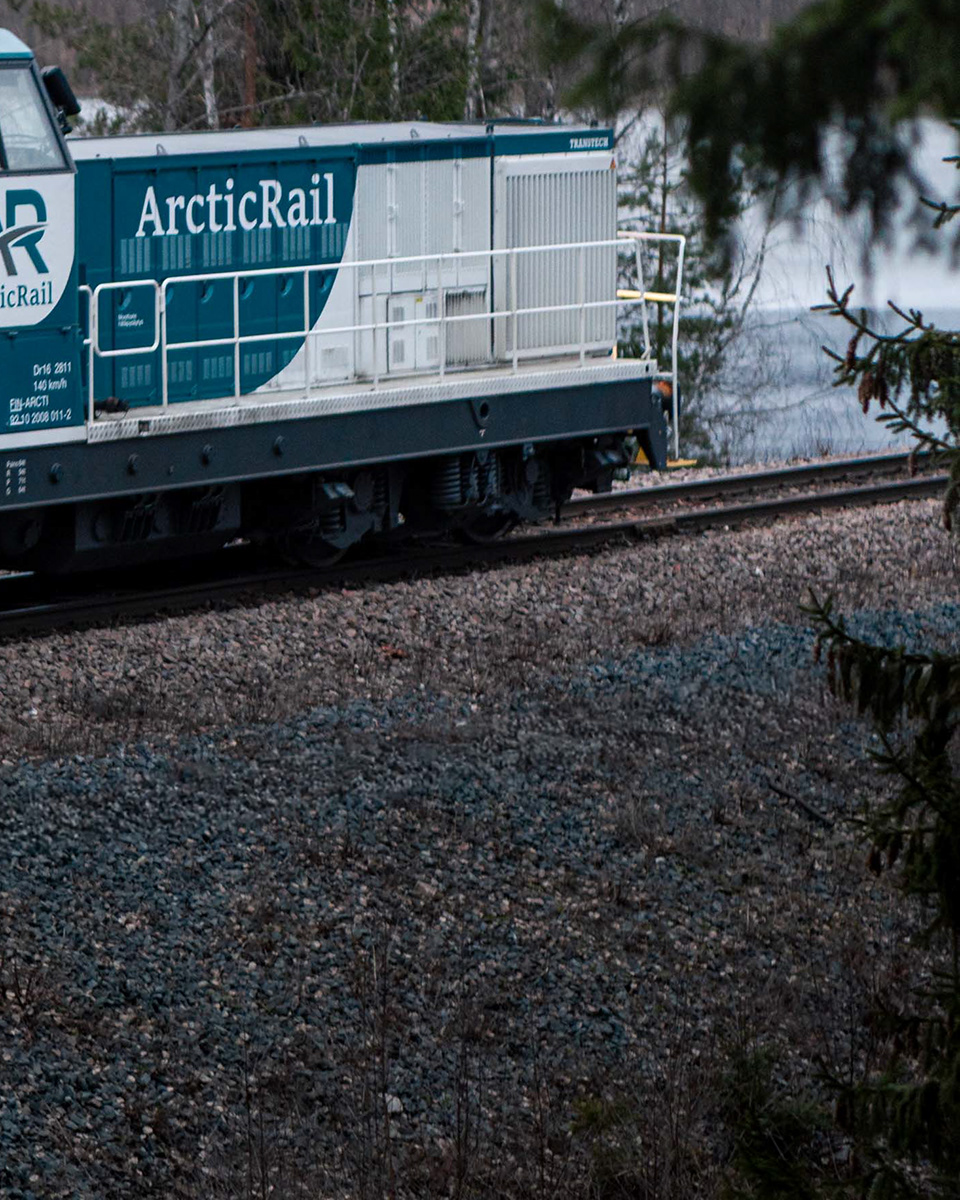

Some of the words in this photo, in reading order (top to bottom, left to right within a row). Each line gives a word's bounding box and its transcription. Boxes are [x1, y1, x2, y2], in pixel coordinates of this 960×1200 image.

[135, 172, 337, 237] ArcticRail
[33, 362, 52, 377] Dr16
[54, 361, 72, 374] 2811
[34, 379, 47, 392] 140
[48, 377, 67, 390] km/h
[10, 395, 49, 412] FIN-ARCTI
[50, 408, 72, 422] 011-2
